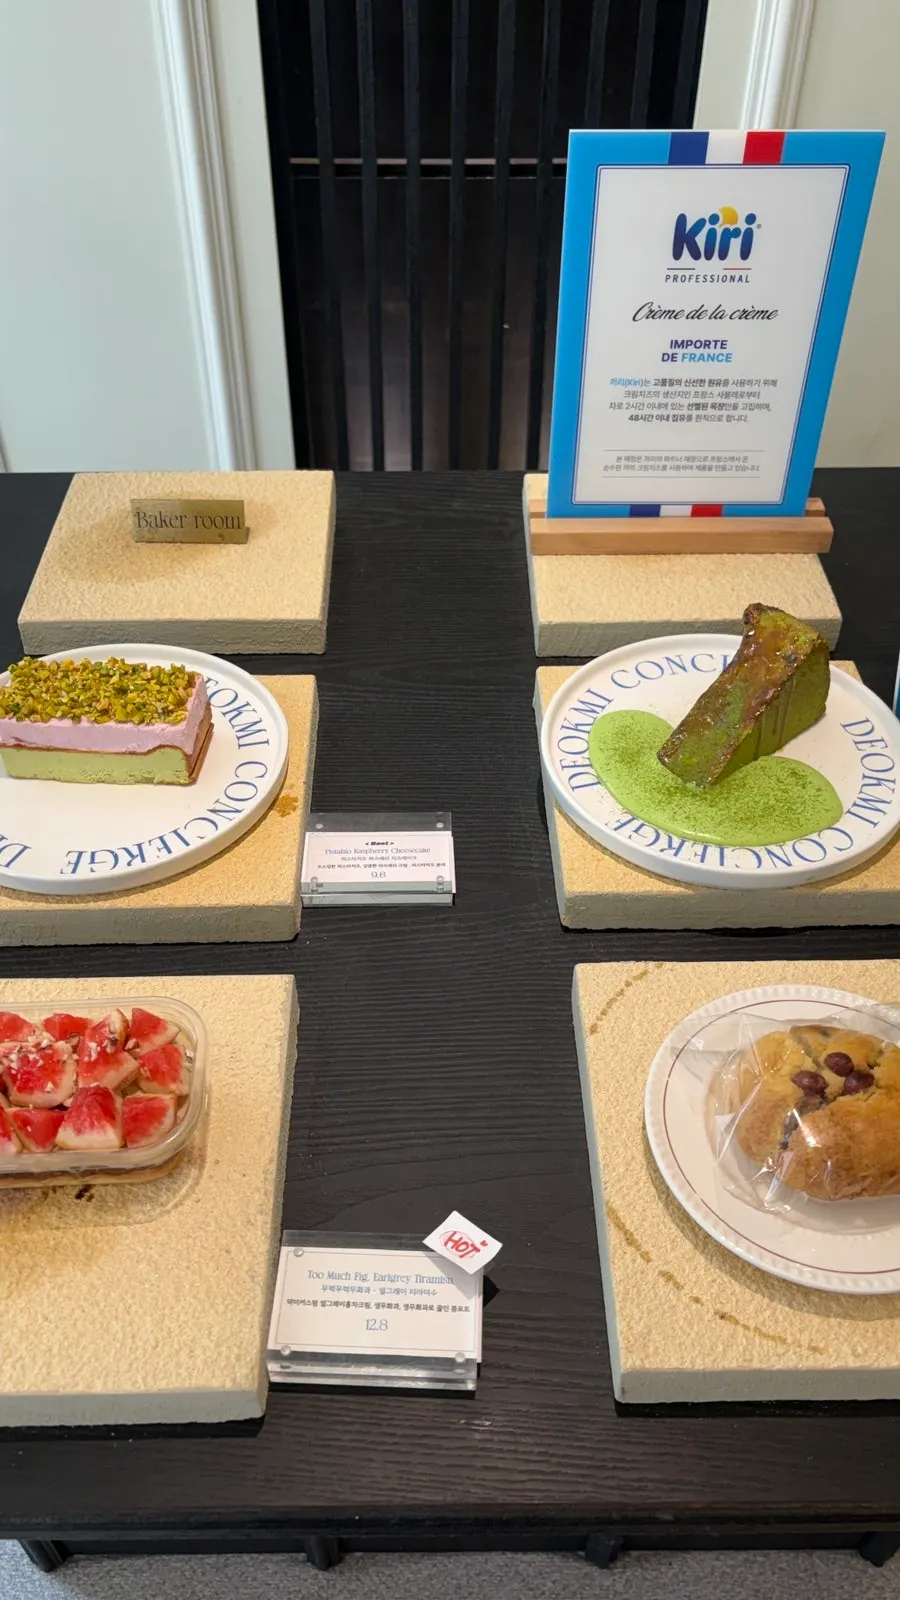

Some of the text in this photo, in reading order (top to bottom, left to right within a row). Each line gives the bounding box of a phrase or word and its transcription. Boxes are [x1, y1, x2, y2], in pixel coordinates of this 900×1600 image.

[672, 213, 757, 261] Kiri
[665, 274, 751, 283] PROFESSIONAL
[632, 301, 779, 322] Crème de la crème
[670, 339, 728, 350] IMPORTE
[661, 352, 733, 363] DE FRANCE
[652, 378, 683, 388] 고품질의
[683, 378, 706, 388] 신선한
[707, 378, 730, 388] 원유를
[731, 378, 761, 388] 사용하기
[763, 379, 778, 388] 위해
[624, 390, 660, 399] 크림치즈의
[662, 390, 691, 399] 생산지인
[692, 391, 715, 399] 프랑스
[609, 402, 624, 410] 차로
[625, 402, 645, 411] 2시간
[646, 402, 669, 411] 이내에
[670, 402, 685, 411] 있는
[686, 402, 709, 411] 선별된
[740, 403, 772, 412] 고집하며,
[628, 414, 750, 422] 48시간 이내 집유를 원칙으로 합니다.
[135, 511, 242, 529] Baker room
[557, 688, 616, 792] DEOKMI
[604, 716, 897, 869] DEOKMI CONCIERGE
[60, 760, 268, 875] CONCIERGE
[443, 1231, 480, 1258] HOT
[308, 1270, 324, 1279] Too
[327, 1271, 351, 1281] Much
[379, 1287, 407, 1295] 얼그레이
[409, 1288, 437, 1296] 티라미수
[365, 1318, 388, 1331] 12.8
